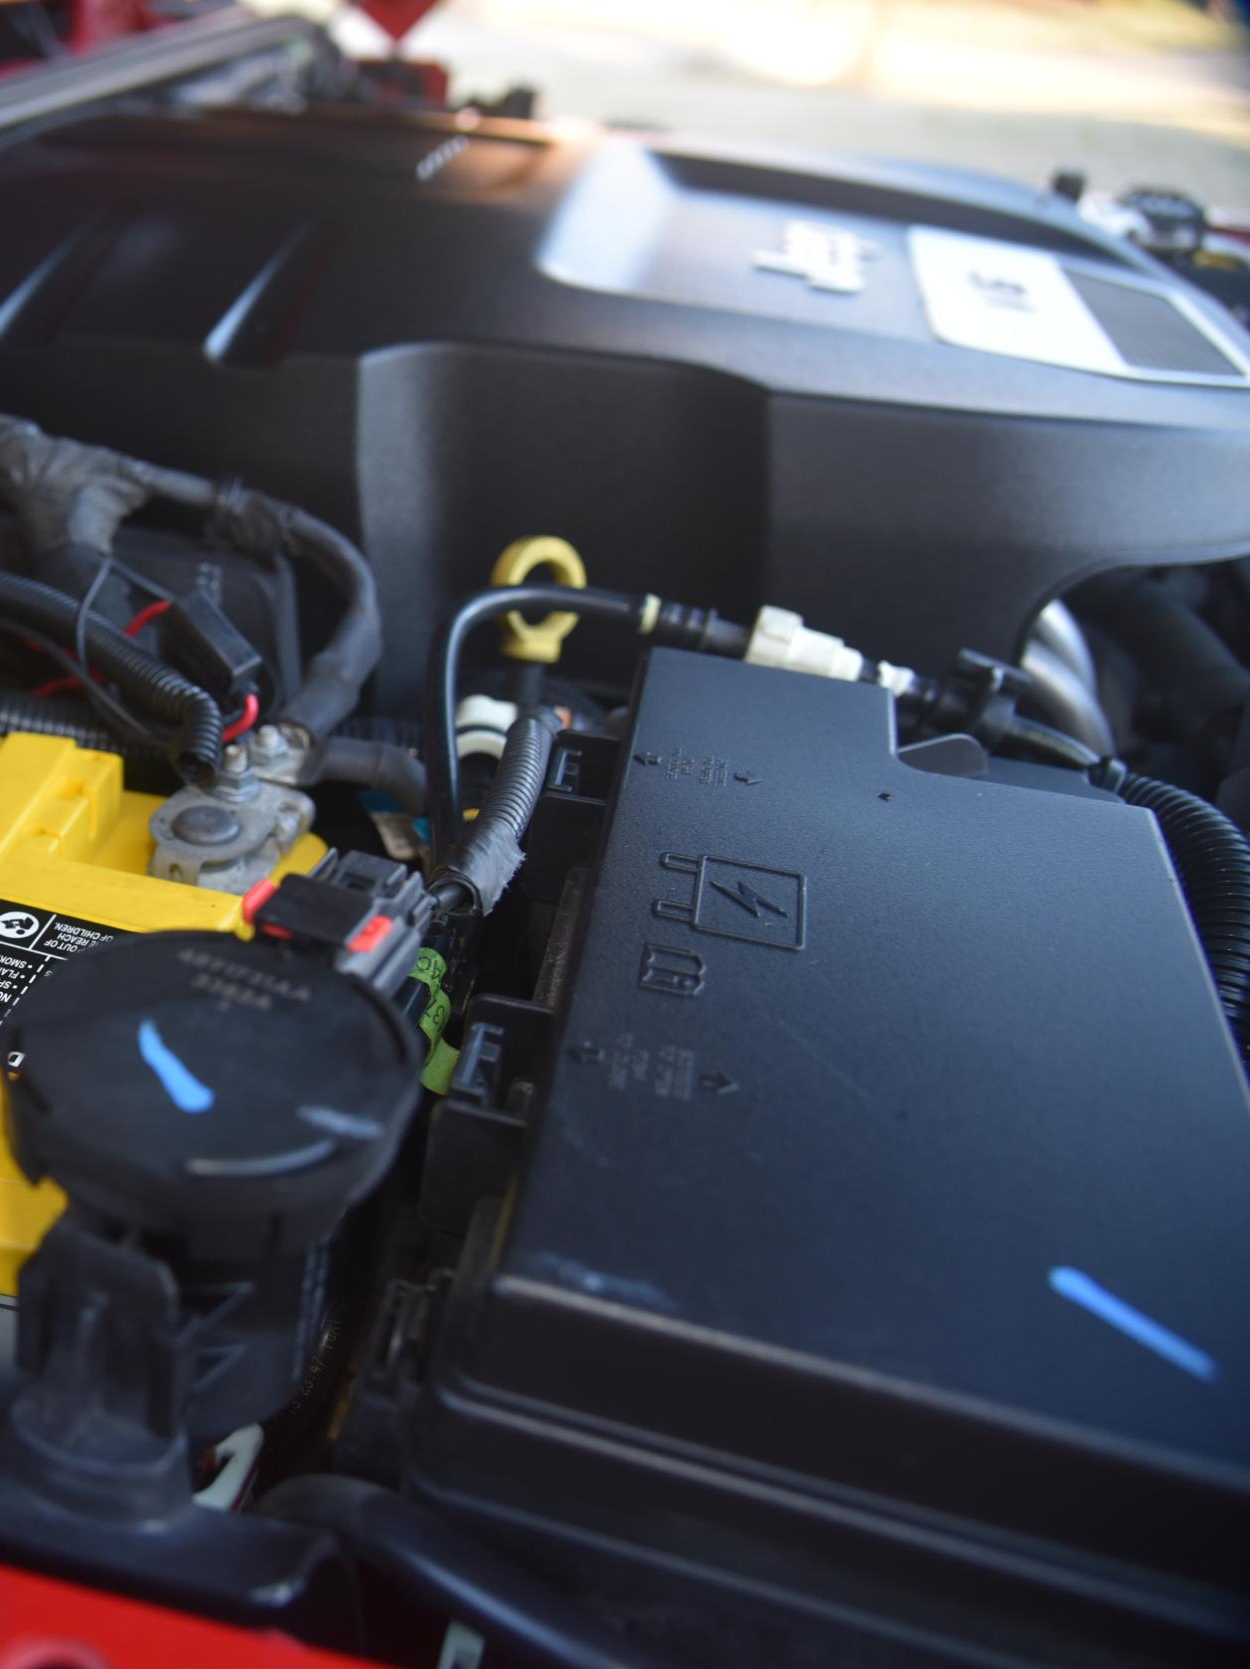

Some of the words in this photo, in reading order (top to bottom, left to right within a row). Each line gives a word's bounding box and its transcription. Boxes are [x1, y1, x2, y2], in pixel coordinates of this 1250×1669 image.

[53, 922, 101, 940] CHILDREN.
[44, 939, 59, 948] OF
[57, 933, 90, 946] REACH
[58, 941, 78, 953] OUT
